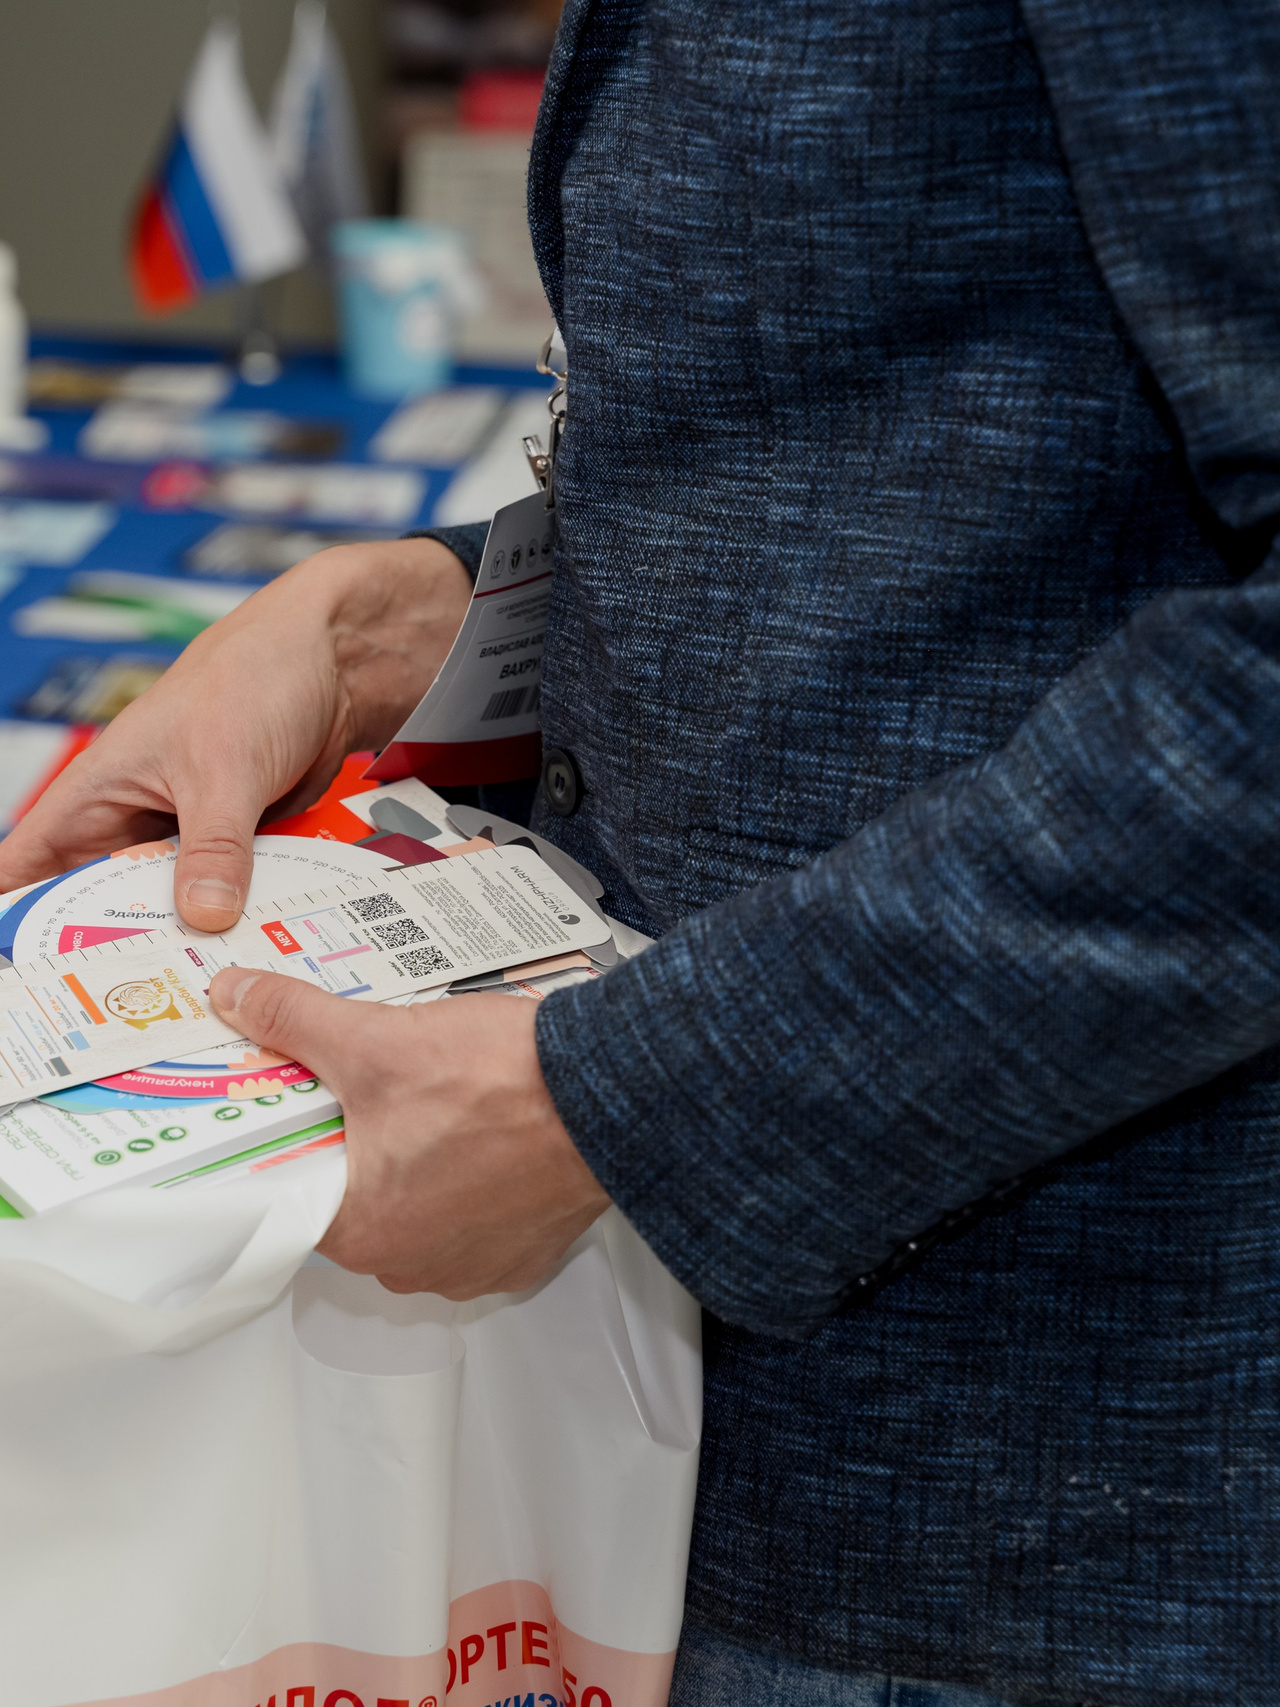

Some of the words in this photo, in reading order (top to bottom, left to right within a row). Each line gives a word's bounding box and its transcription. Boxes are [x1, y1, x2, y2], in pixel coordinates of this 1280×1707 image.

[499, 656, 542, 679] ВАХРУ
[42, 929, 51, 937] 60
[47, 917, 57, 925] 70
[55, 906, 66, 914] 80
[66, 896, 77, 904] 90
[77, 886, 91, 895] 100
[92, 878, 106, 886] 110
[108, 870, 123, 879] 120
[126, 864, 142, 872] 130
[271, 852, 290, 860] 200
[311, 860, 329, 868] 220
[329, 866, 346, 874] 230
[346, 872, 363, 881] 240
[510, 865, 562, 914] NIZHPHARM
[547, 891, 570, 911] GROUP
[103, 909, 174, 919] Эдарби®
[149, 977, 169, 994] лет
[163, 967, 181, 985] Кло
[121, 1074, 214, 1089] Некурящие
